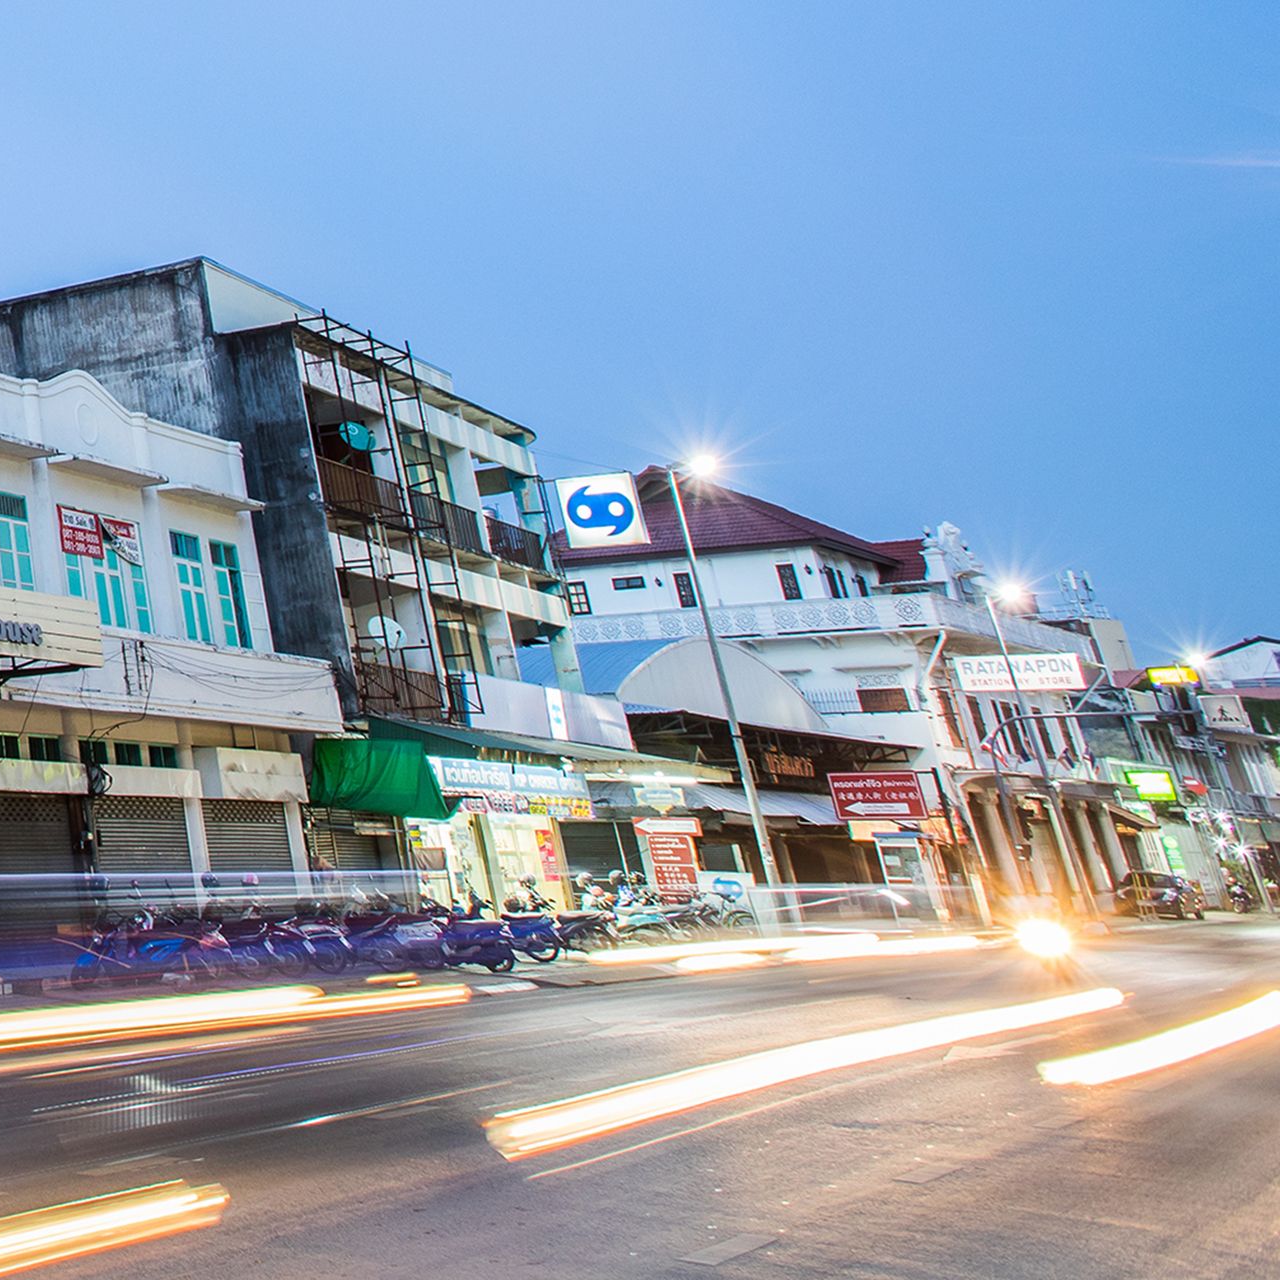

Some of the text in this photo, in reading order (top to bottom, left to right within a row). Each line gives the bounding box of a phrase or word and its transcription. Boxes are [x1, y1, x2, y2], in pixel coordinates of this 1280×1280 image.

[961, 658, 1074, 676] RATANAPON
[970, 676, 1073, 687] STATIONRY STORE
